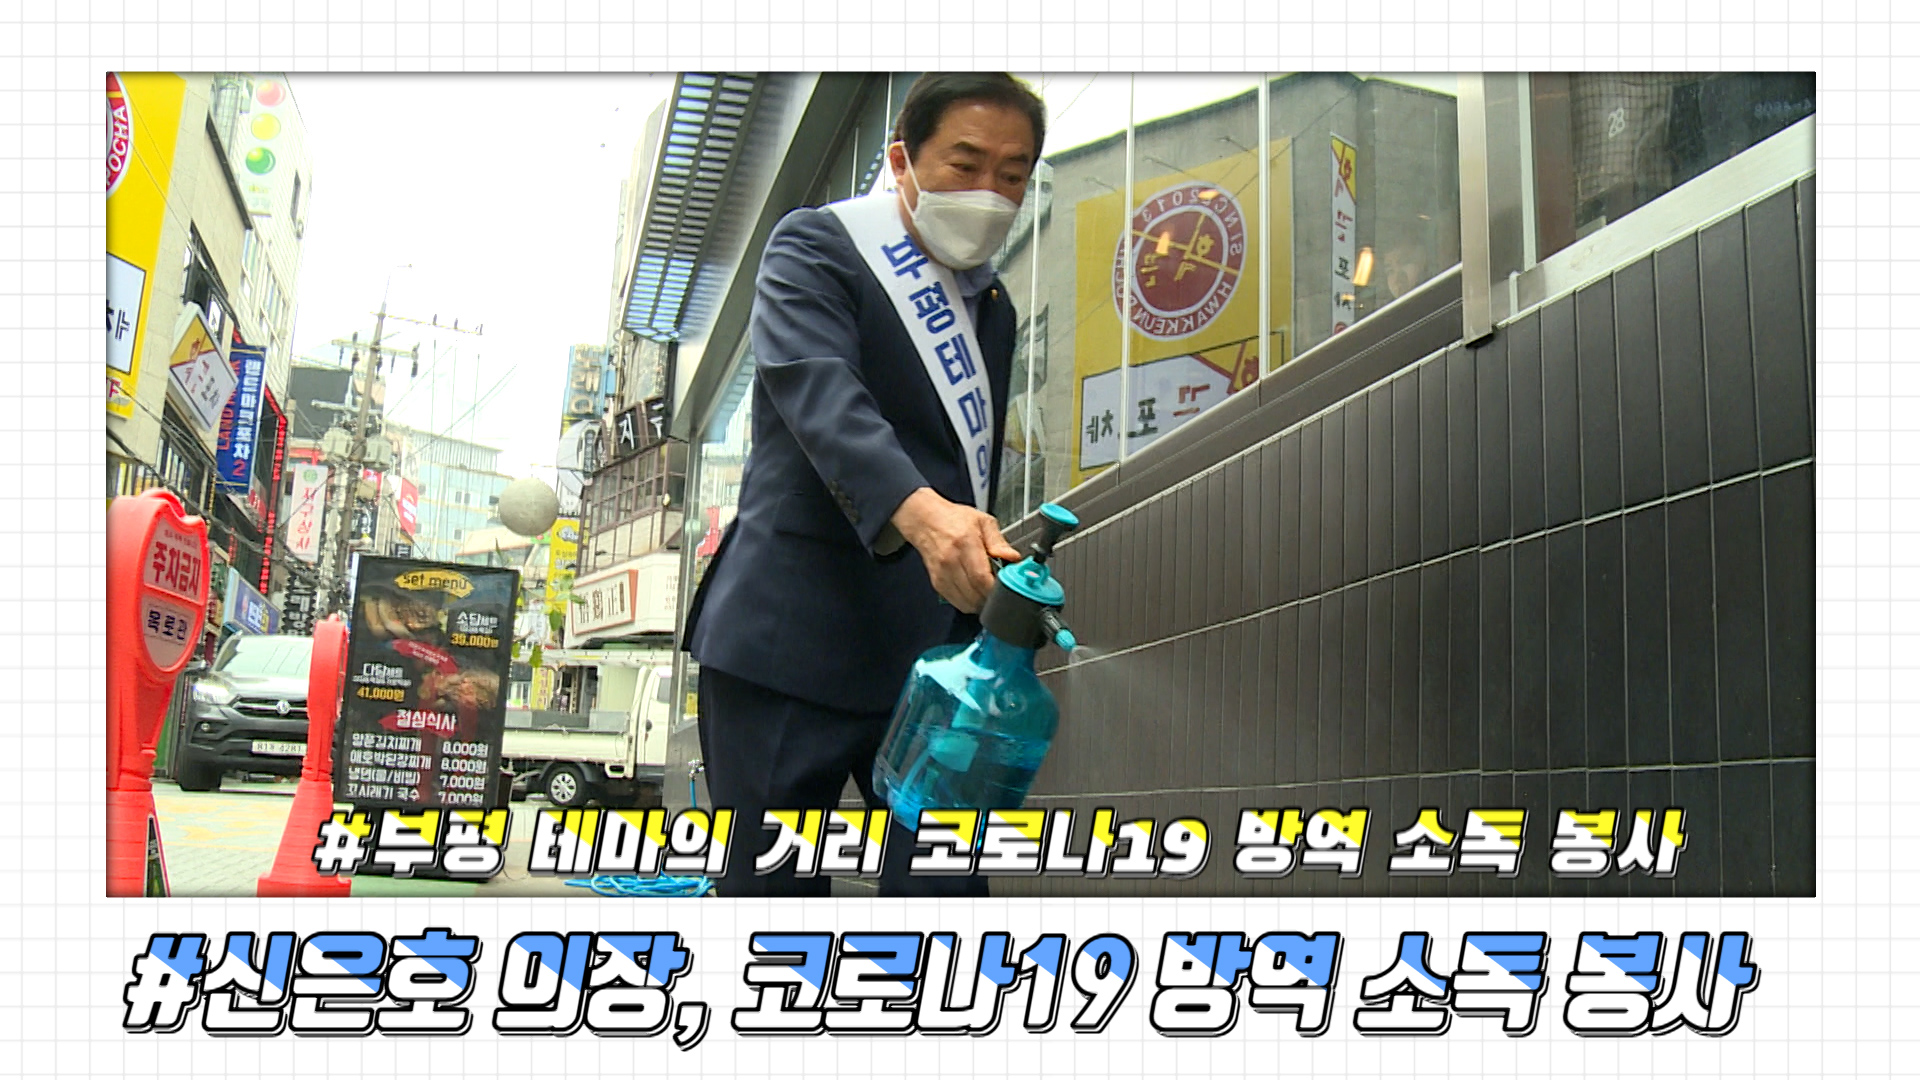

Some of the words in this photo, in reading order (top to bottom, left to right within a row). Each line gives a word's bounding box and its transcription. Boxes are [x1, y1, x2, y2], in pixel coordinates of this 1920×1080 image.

[232, 459, 246, 477] 2
[402, 573, 425, 585] set
[396, 709, 458, 731] 점심식사
